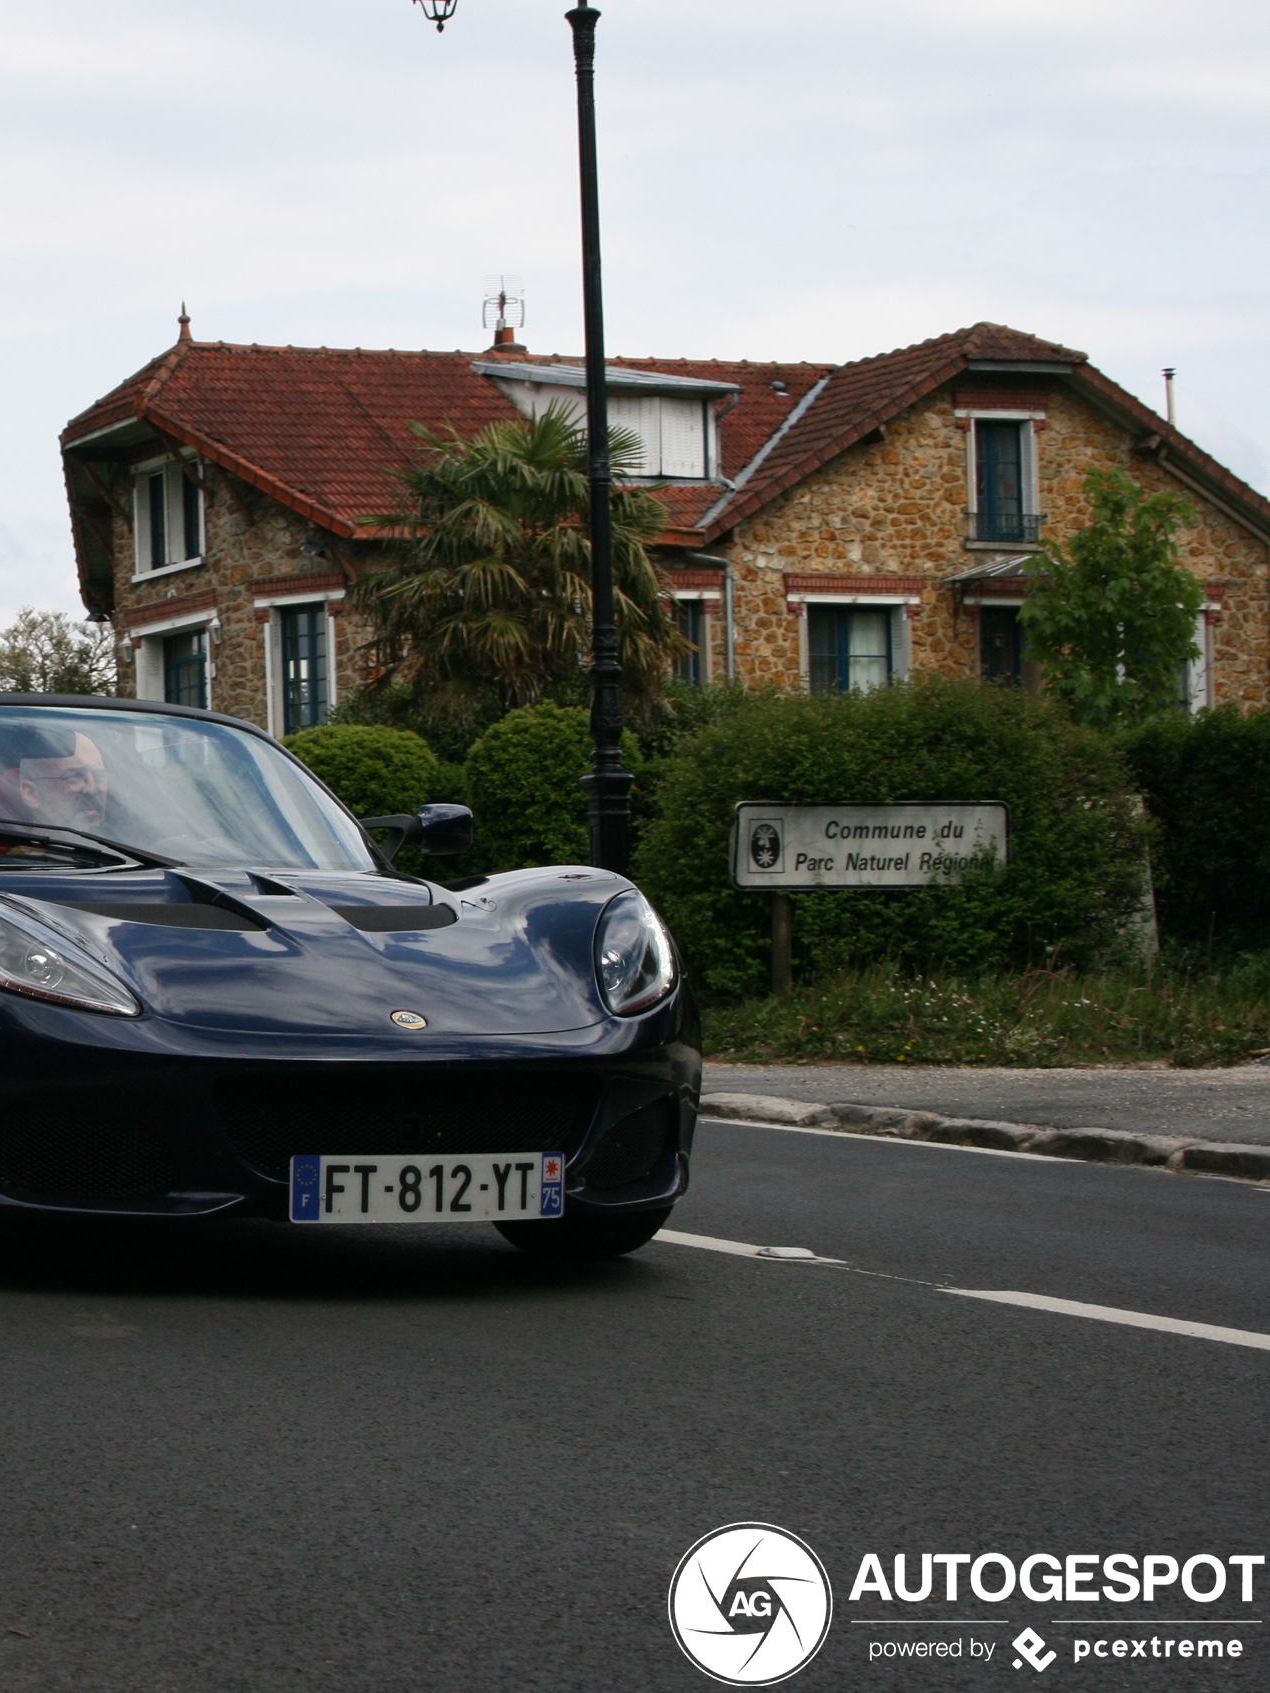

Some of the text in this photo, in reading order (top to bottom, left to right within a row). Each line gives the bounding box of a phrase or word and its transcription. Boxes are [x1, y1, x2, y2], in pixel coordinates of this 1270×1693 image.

[825, 820, 964, 839] Commune du
[794, 853, 835, 871] Parc
[845, 852, 910, 871] Naturel
[325, 1162, 535, 1213] FT-812-YT
[302, 1194, 310, 1207] F
[542, 1187, 560, 1209] 75
